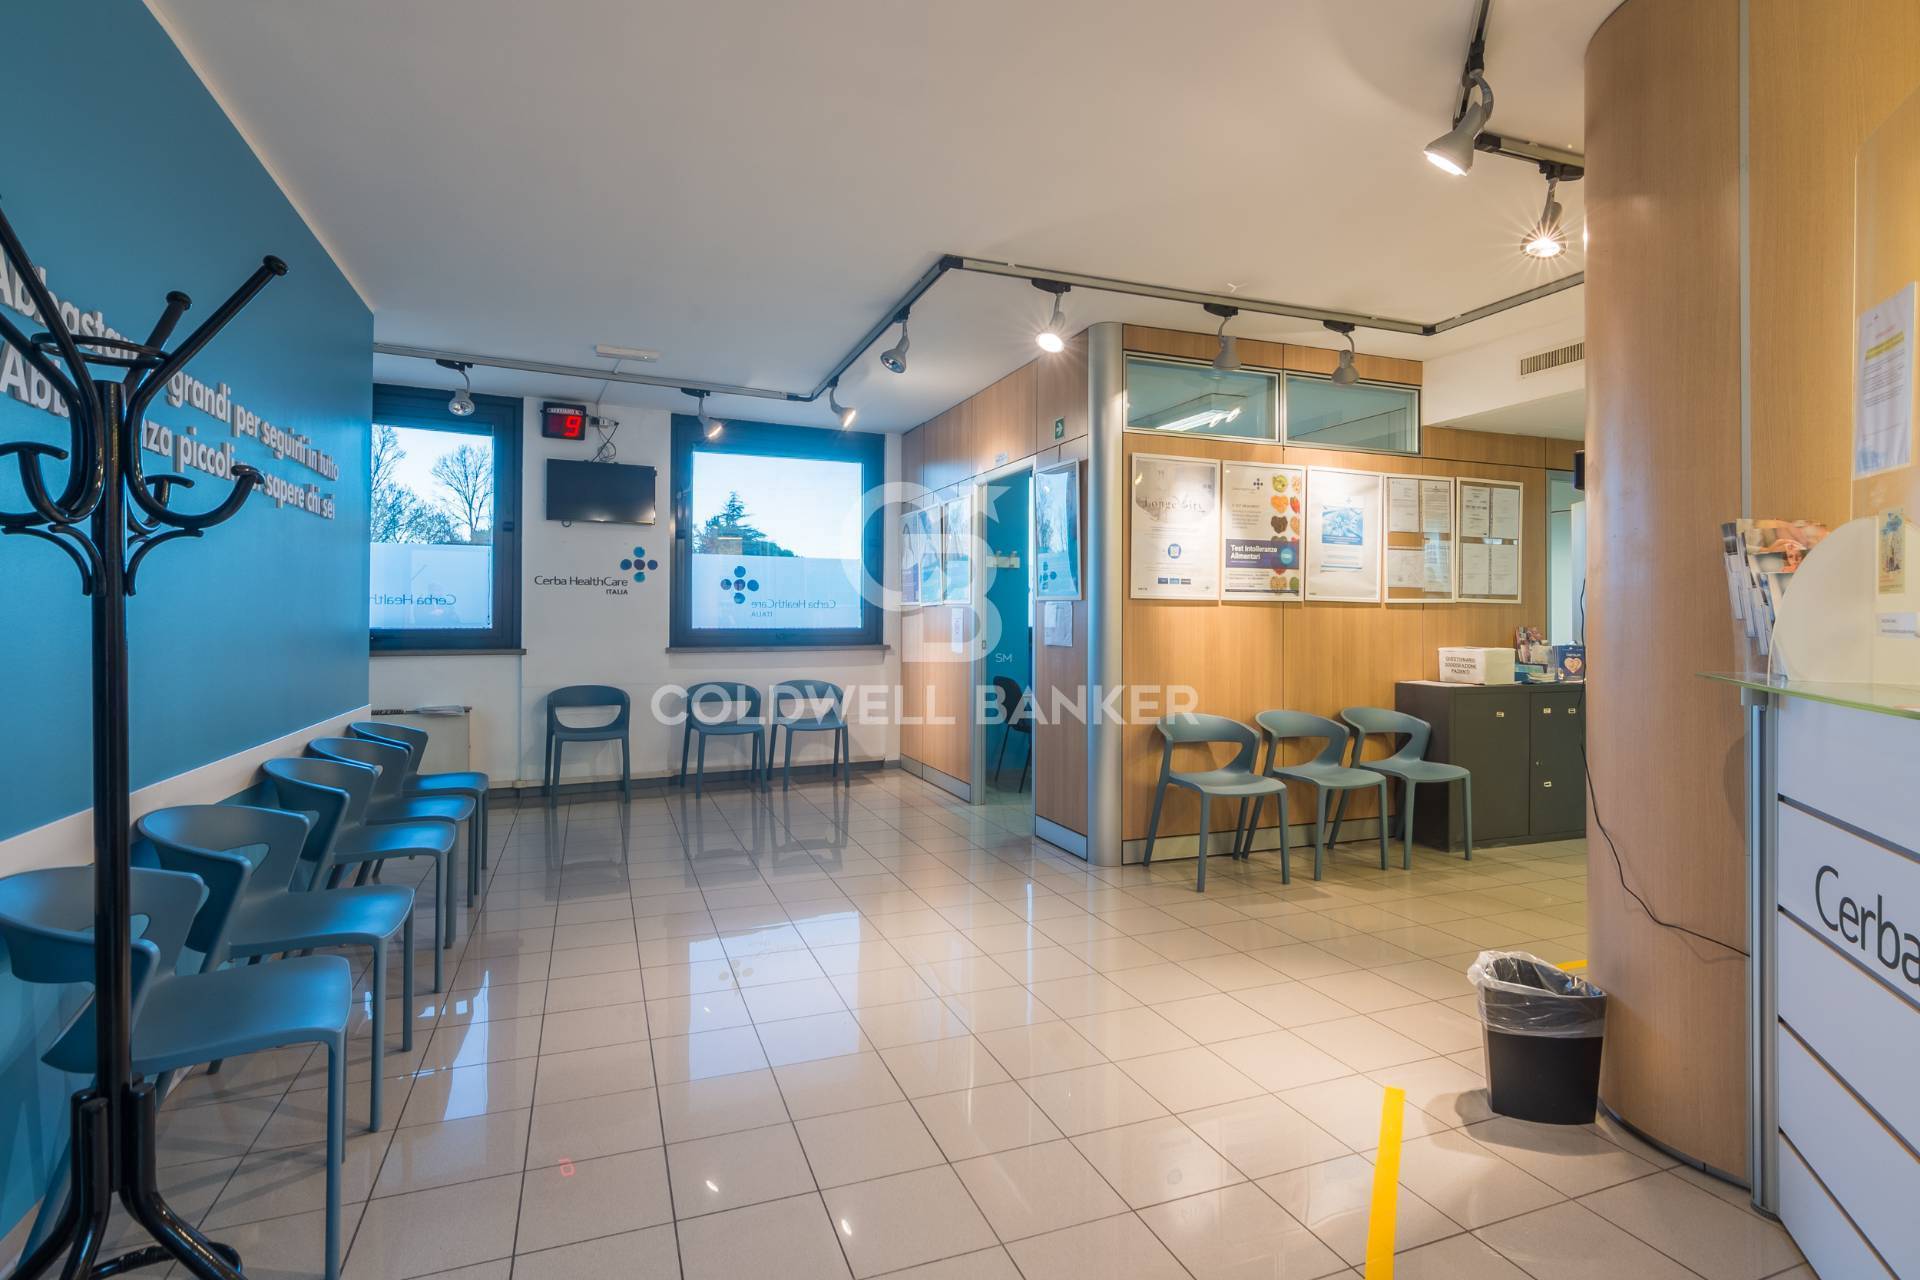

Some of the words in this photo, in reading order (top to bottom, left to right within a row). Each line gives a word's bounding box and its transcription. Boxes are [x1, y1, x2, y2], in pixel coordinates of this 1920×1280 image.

[166, 371, 231, 423] grandi
[233, 404, 260, 438] per
[564, 415, 582, 437] 9
[173, 426, 235, 481] piccoli
[265, 473, 304, 508] sapere
[1230, 544, 1245, 552] Test
[534, 575, 567, 586] Cerba
[569, 576, 629, 587] HealthCare
[1815, 865, 1920, 986] Cerba
